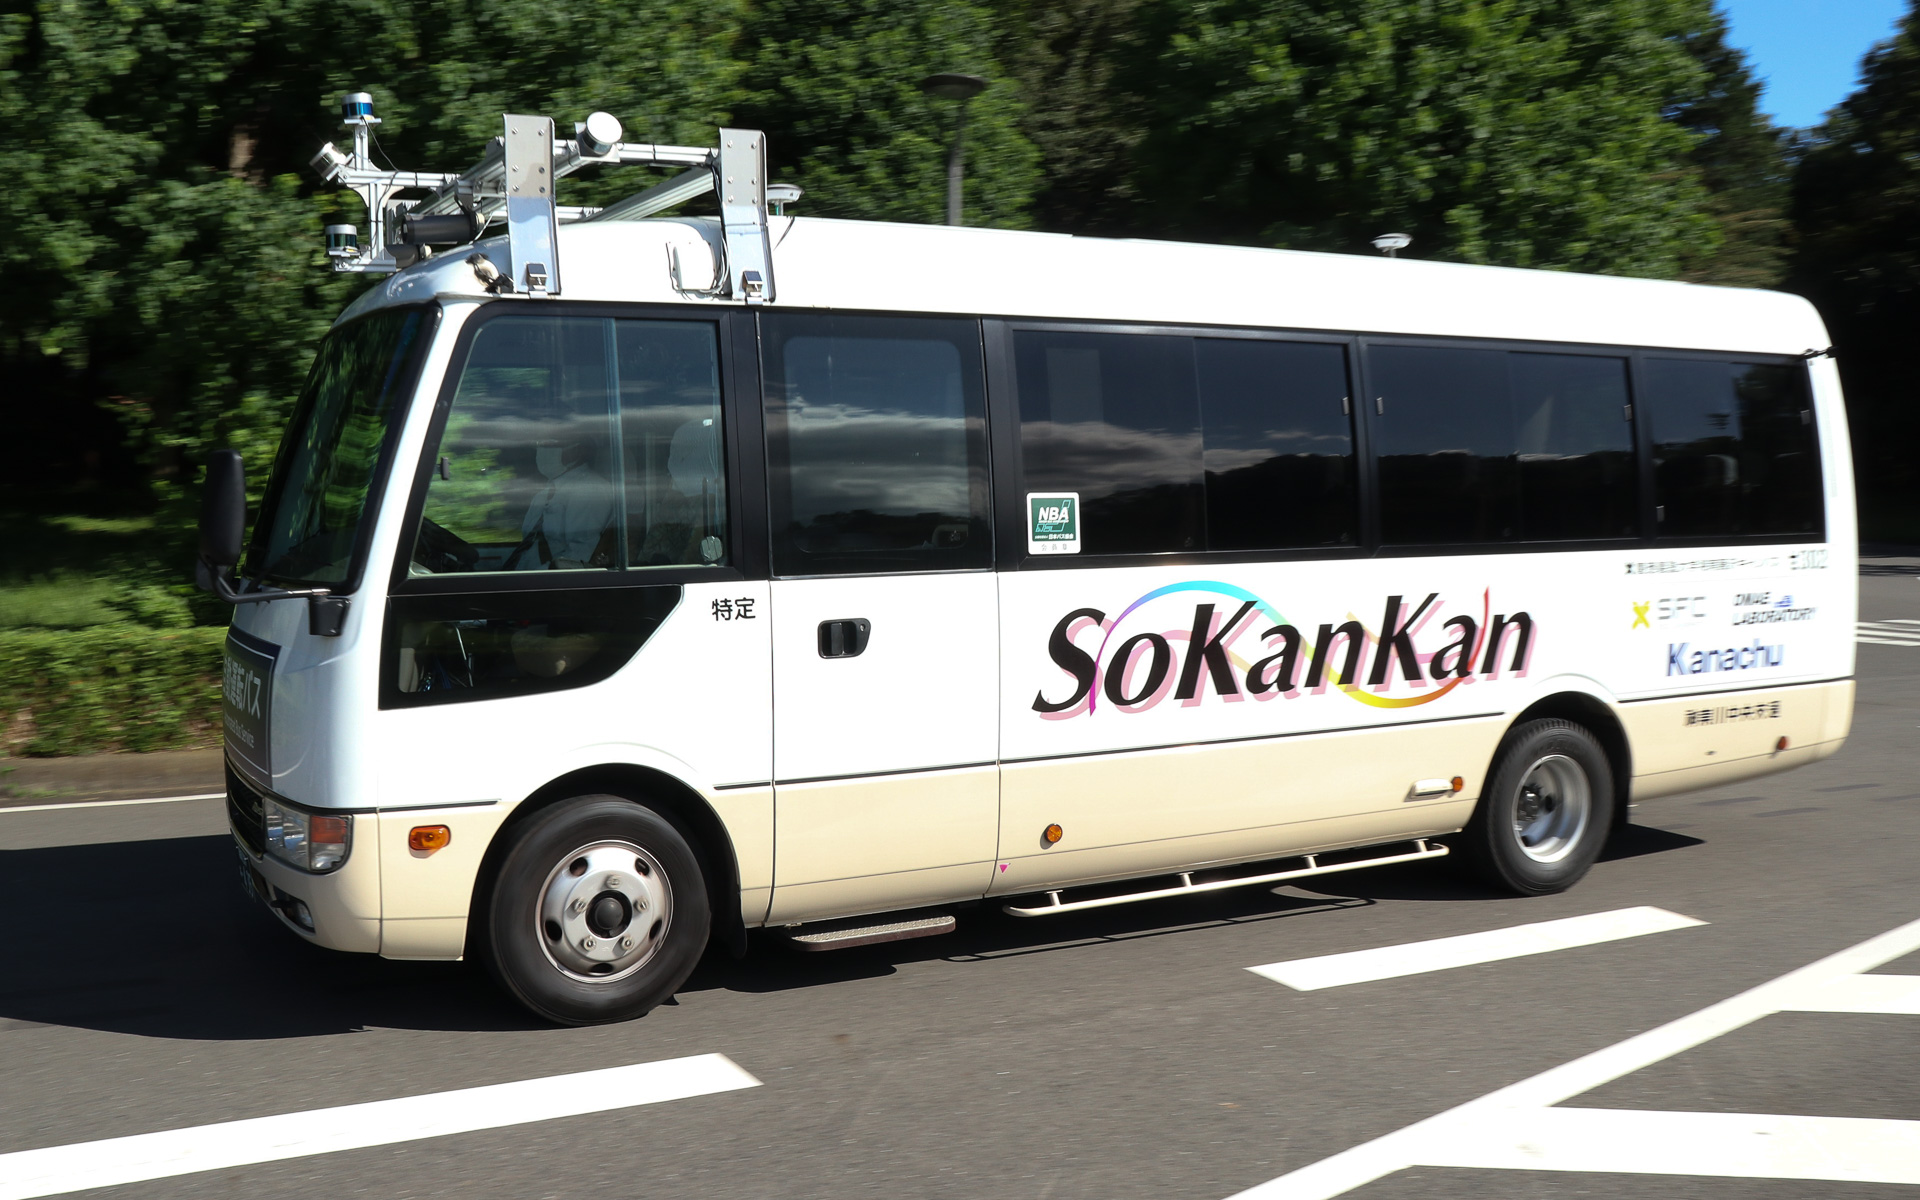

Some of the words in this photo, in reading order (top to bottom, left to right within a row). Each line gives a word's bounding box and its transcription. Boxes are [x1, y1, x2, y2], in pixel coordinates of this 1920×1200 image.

[1038, 506, 1069, 521] NBA
[711, 597, 756, 621] 特定
[1031, 592, 1537, 720] SoKanKan
[1665, 638, 1784, 677] Kanachu
